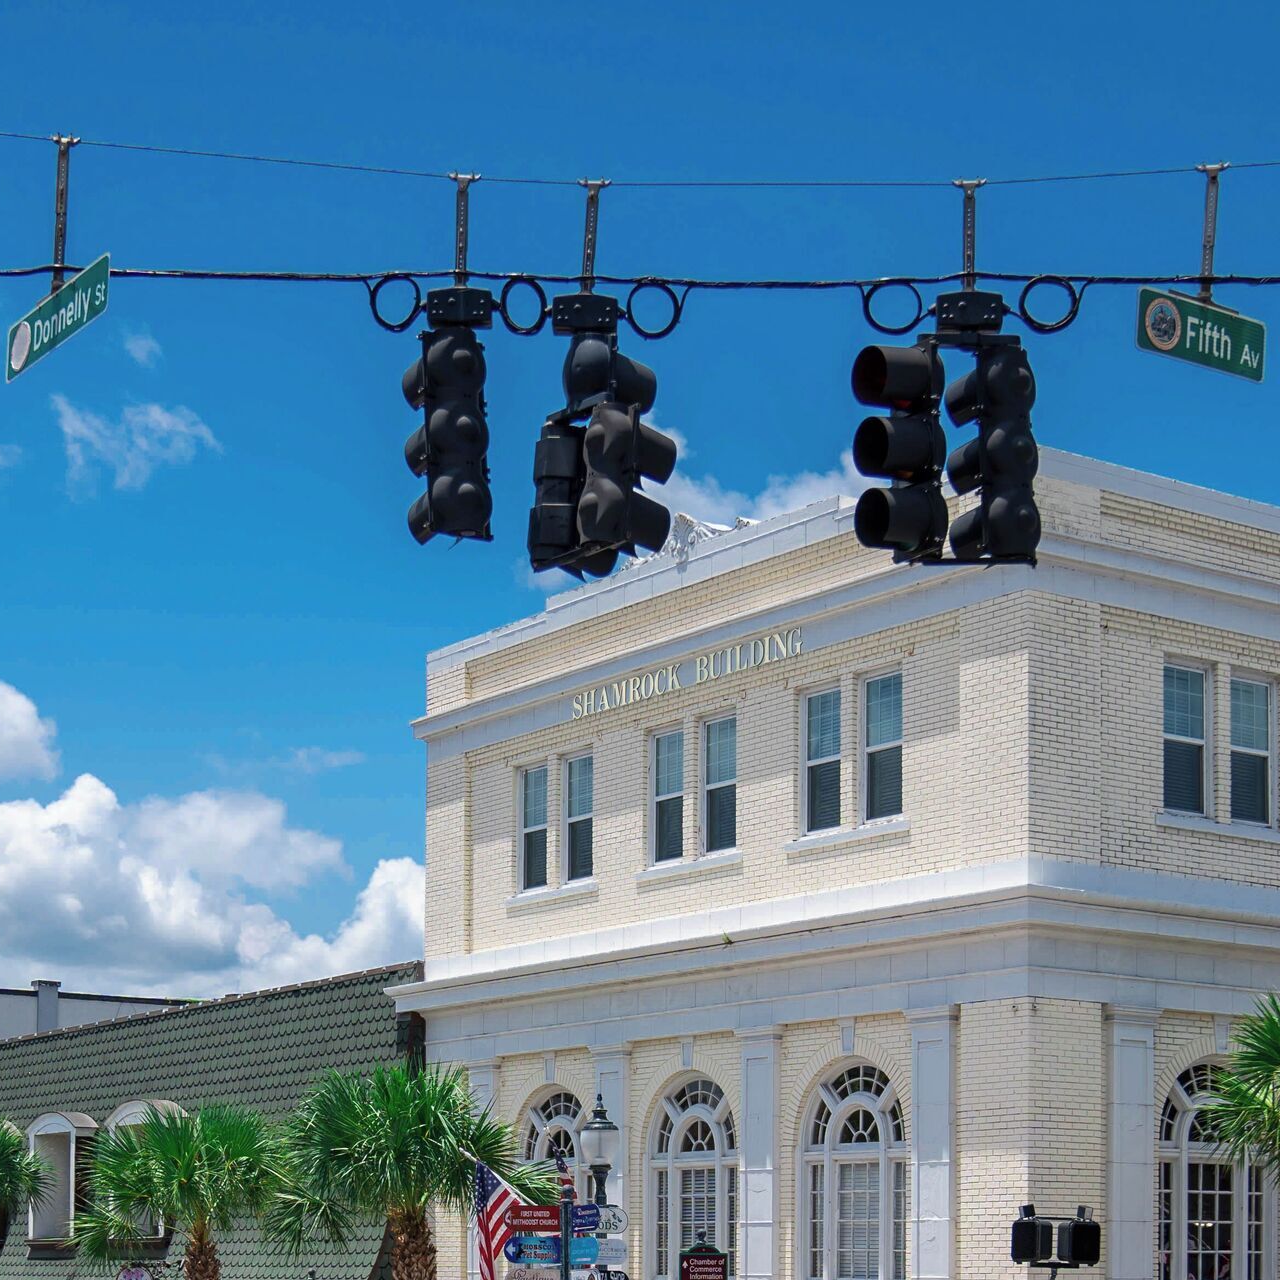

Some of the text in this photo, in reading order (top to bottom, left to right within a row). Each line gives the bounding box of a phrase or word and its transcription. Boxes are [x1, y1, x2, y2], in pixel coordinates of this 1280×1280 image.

[33, 281, 106, 351] Donnelly St
[1185, 316, 1260, 369] Fifth Av
[572, 626, 803, 720] SHAMROCK BUILDING
